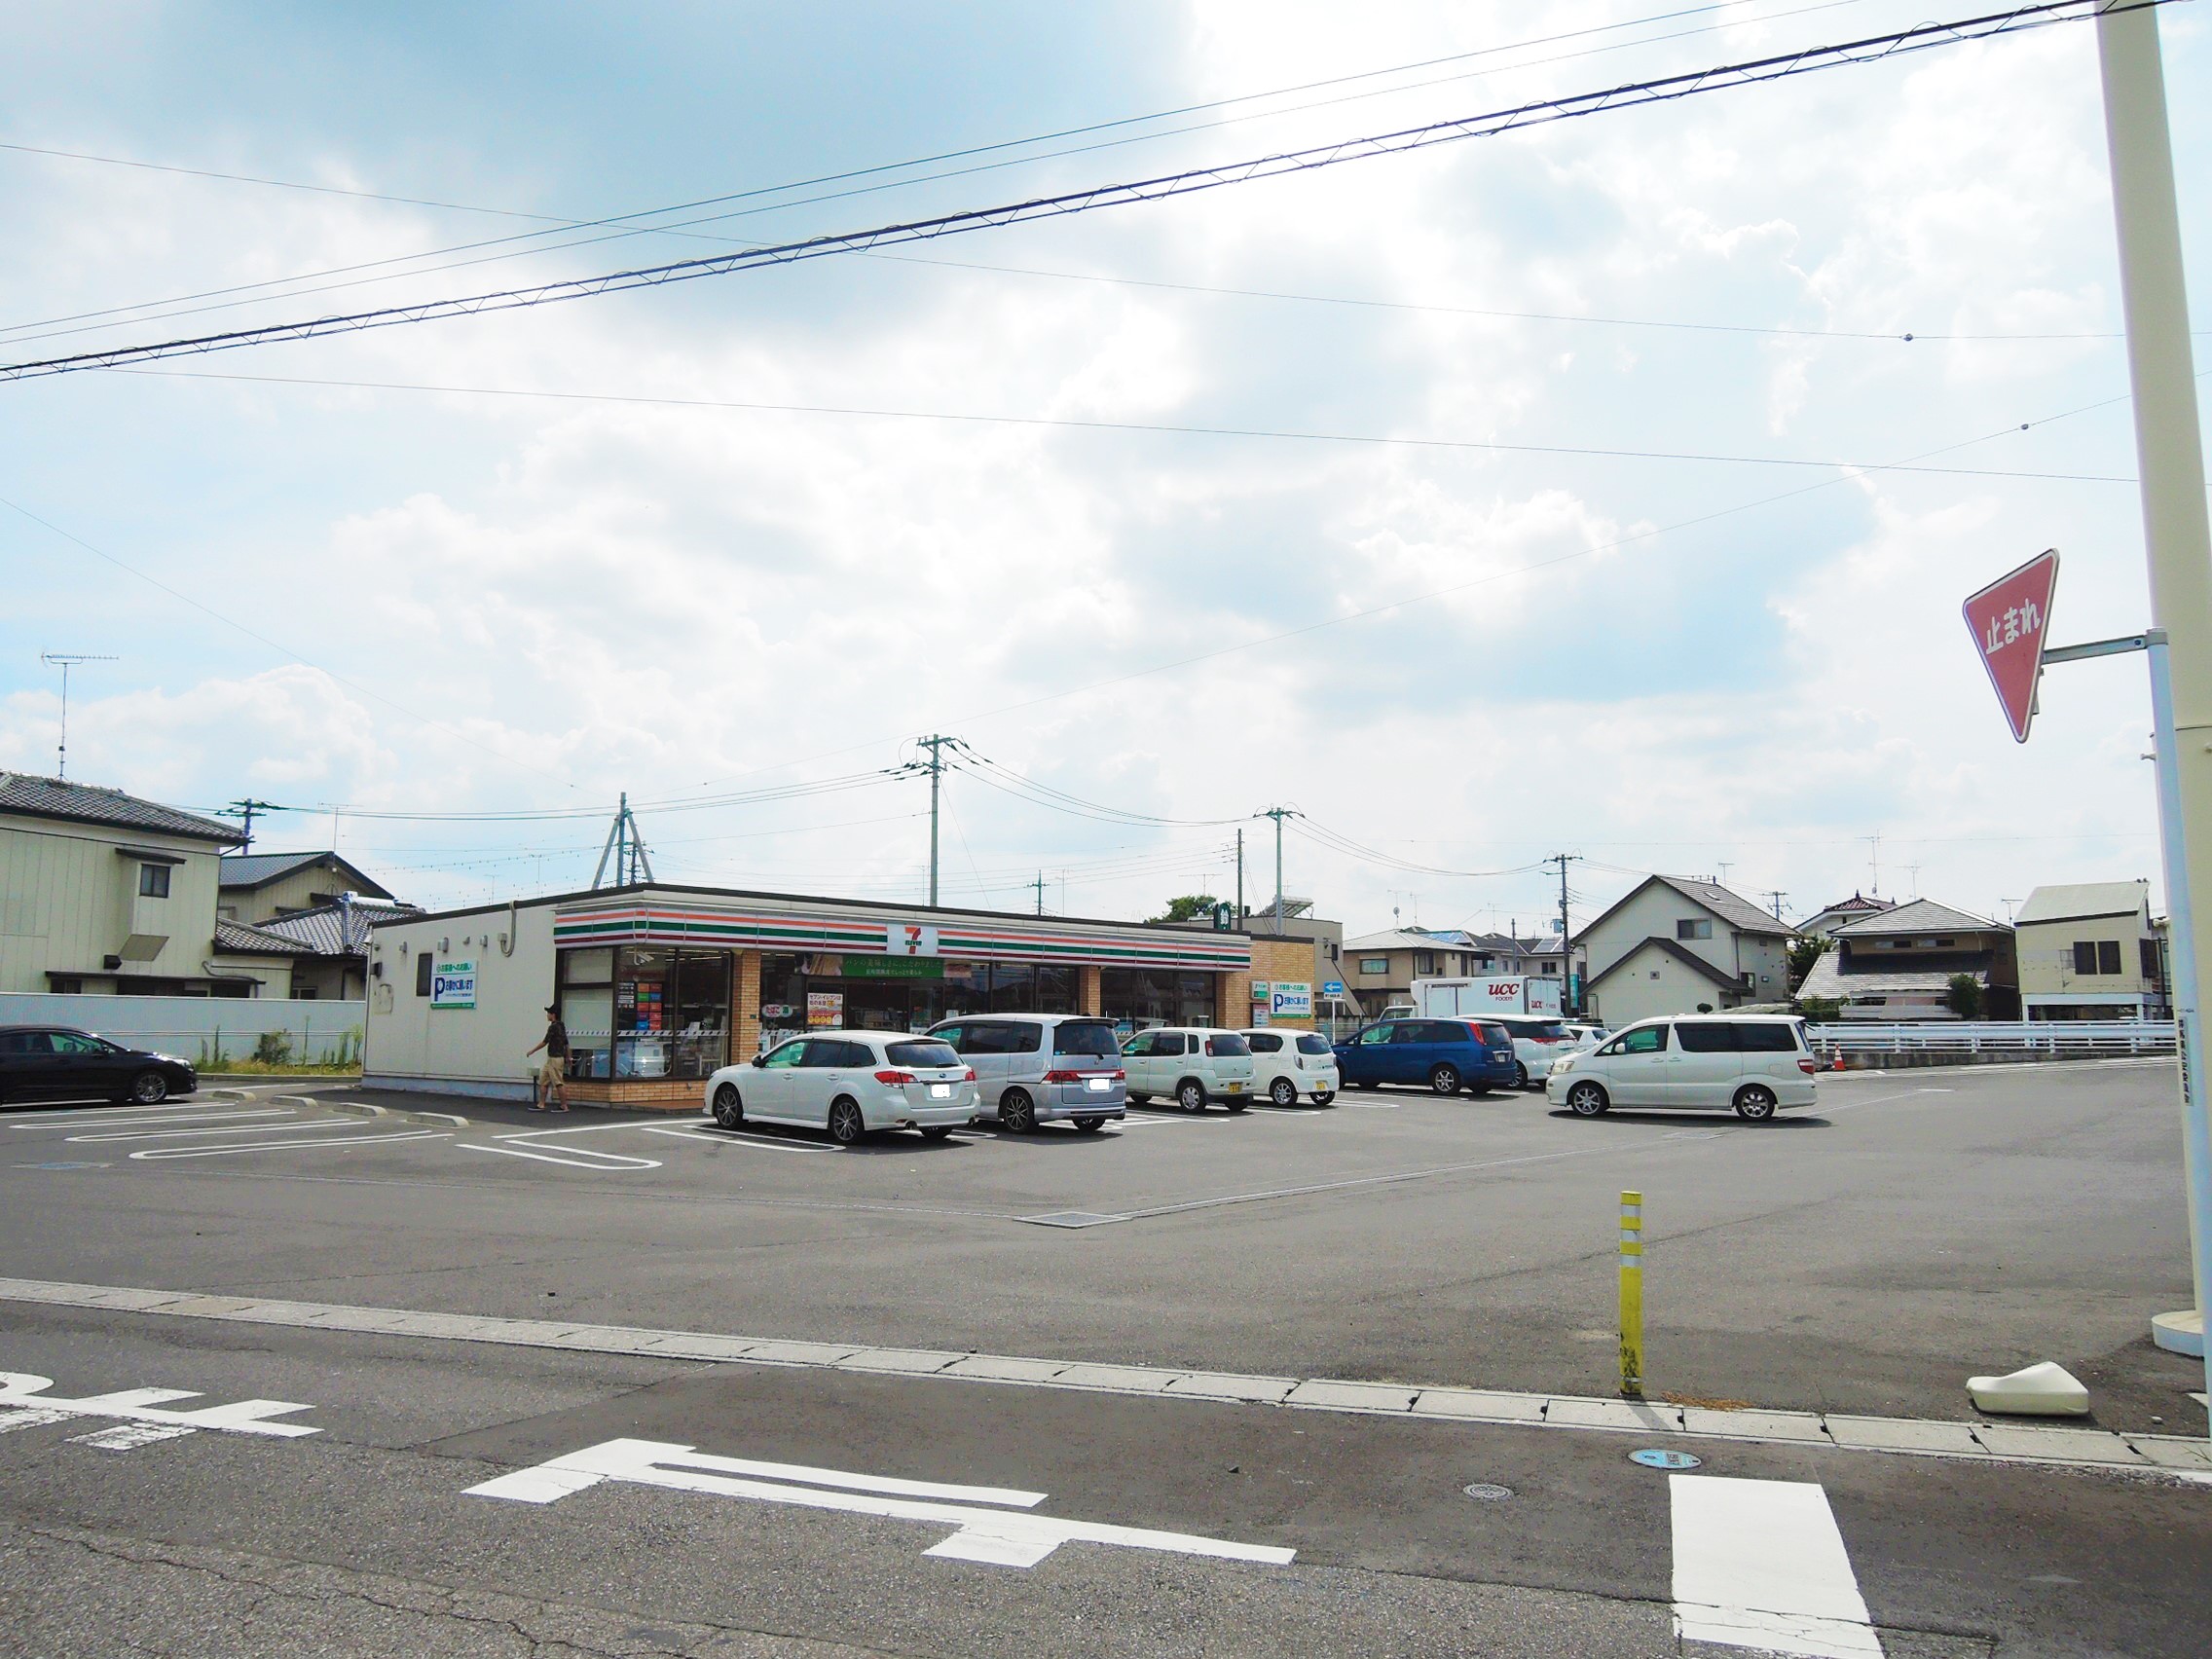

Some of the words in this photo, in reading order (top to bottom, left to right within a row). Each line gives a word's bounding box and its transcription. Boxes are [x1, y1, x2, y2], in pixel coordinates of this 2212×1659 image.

[1986, 598, 2042, 654] 止まれ
[905, 926, 922, 954] 7
